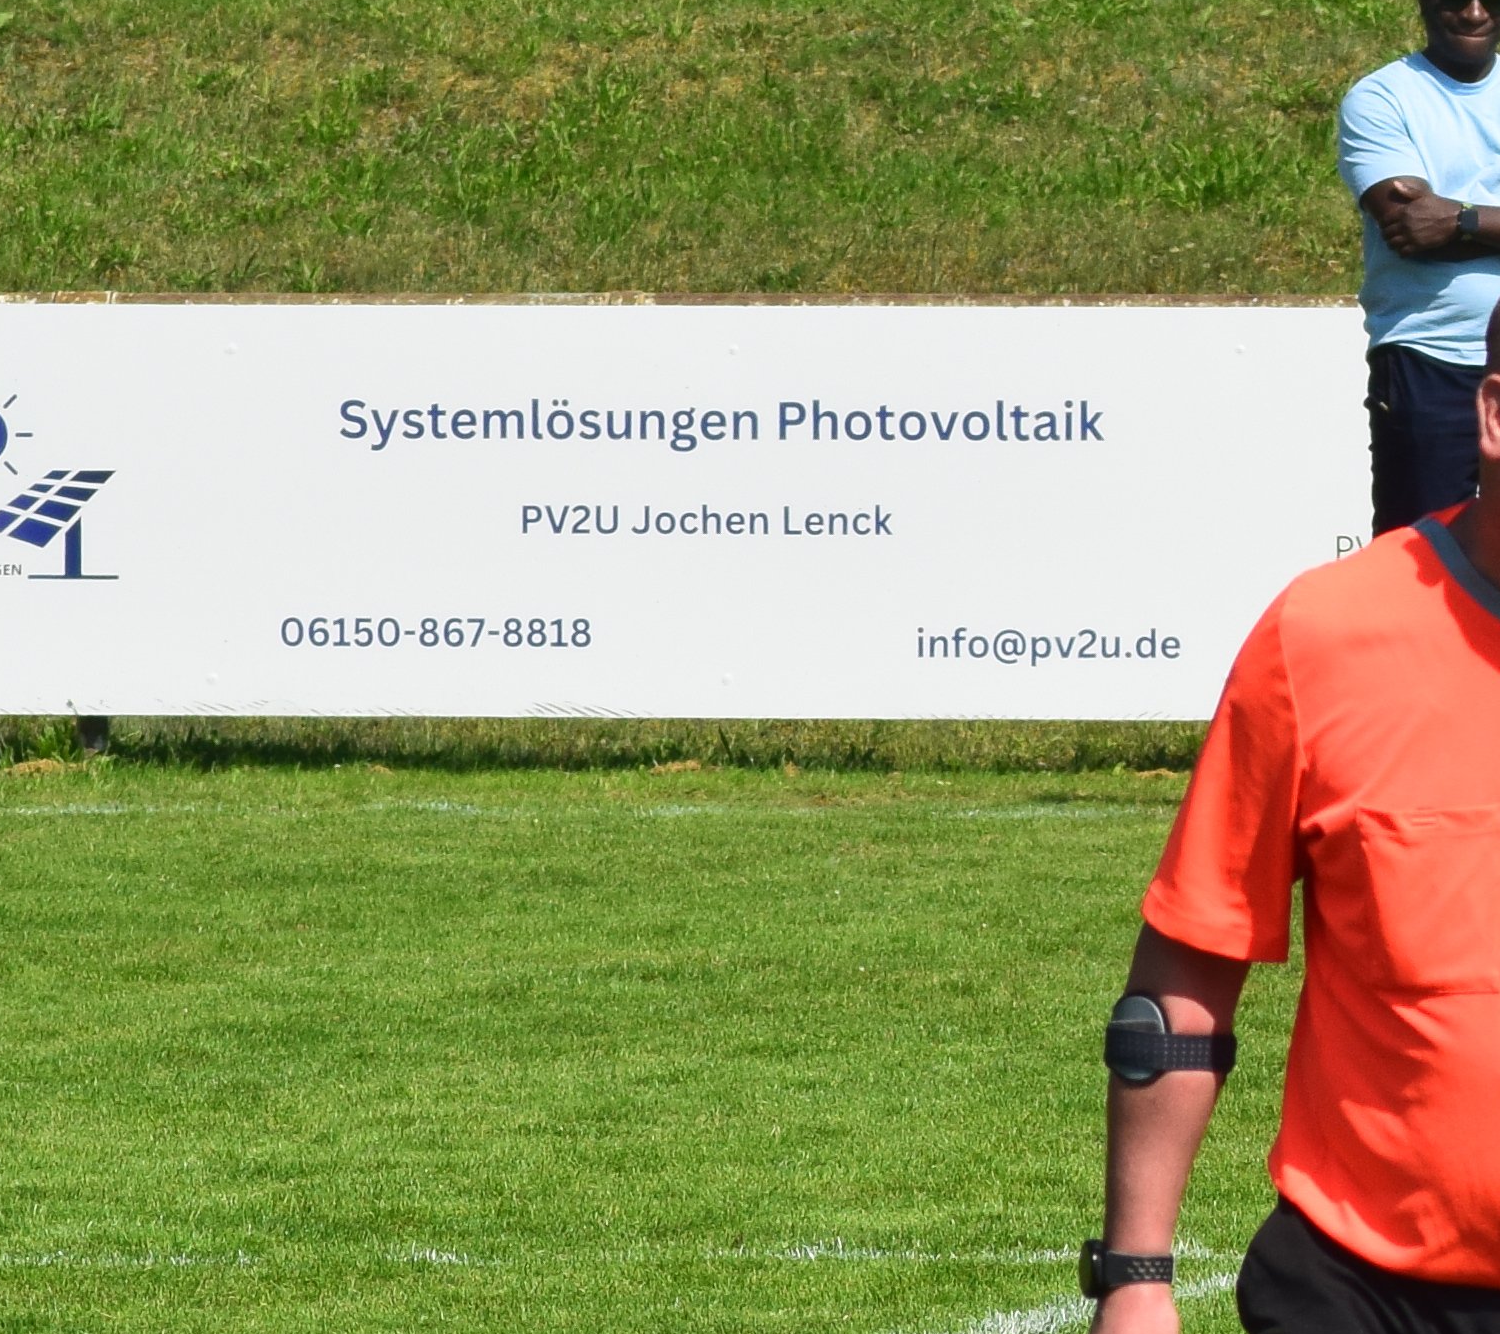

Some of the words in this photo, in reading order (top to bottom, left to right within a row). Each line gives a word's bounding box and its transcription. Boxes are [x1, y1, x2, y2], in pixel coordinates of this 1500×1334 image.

[339, 399, 761, 453] Systemlösungen
[778, 400, 1105, 443] Photovoltaik
[521, 505, 621, 537] PV2U
[631, 504, 771, 537] Jochen
[783, 505, 895, 538] Lenck
[280, 616, 594, 650] 06150-867-8818
[917, 626, 1183, 668] info@pv2u.de
